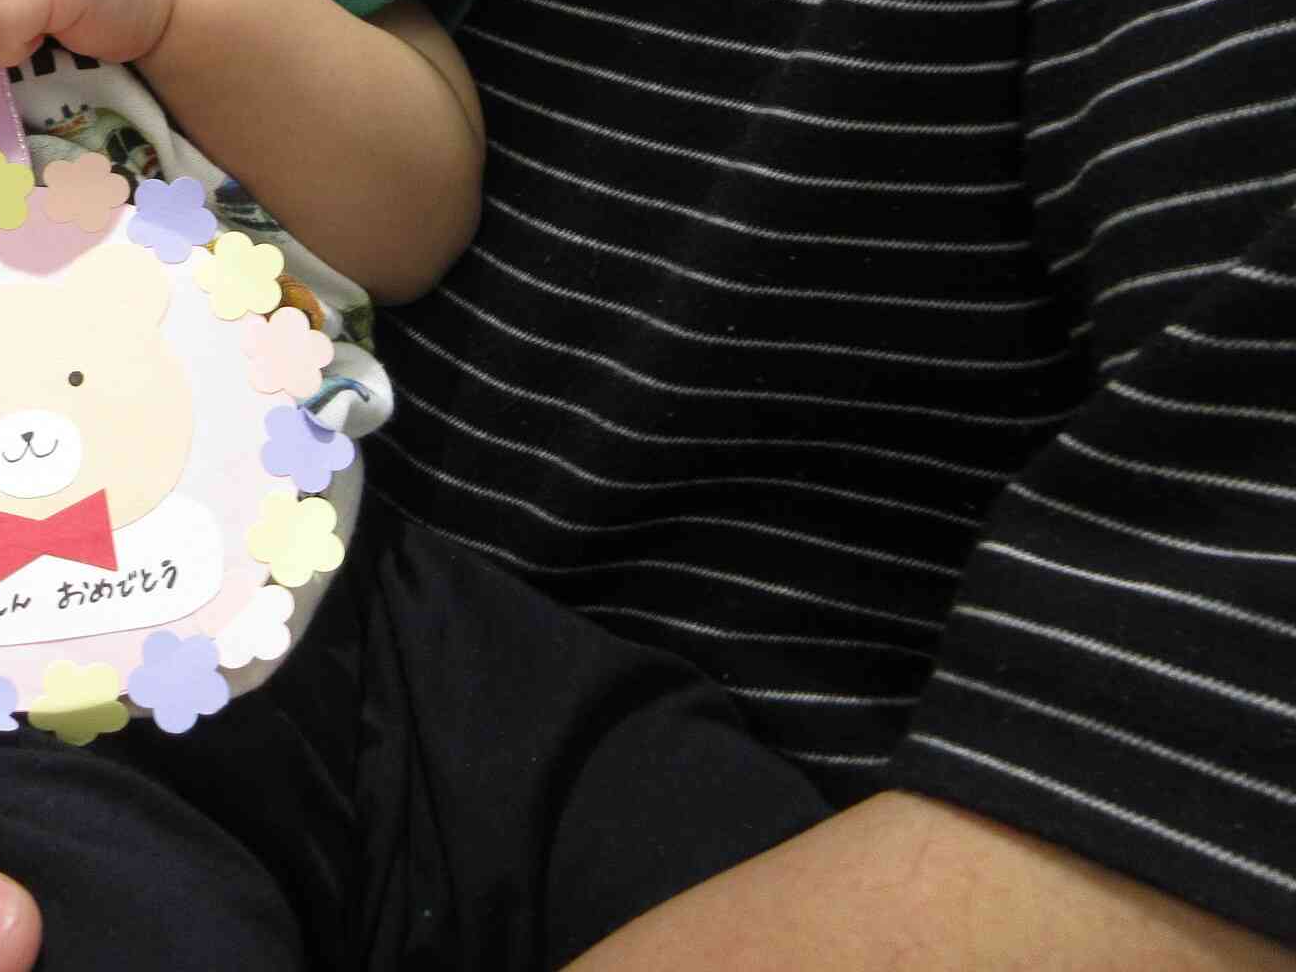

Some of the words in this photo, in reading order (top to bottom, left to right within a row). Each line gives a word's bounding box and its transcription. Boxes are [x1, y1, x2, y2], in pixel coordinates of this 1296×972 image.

[56, 559, 179, 610] おめでとう
